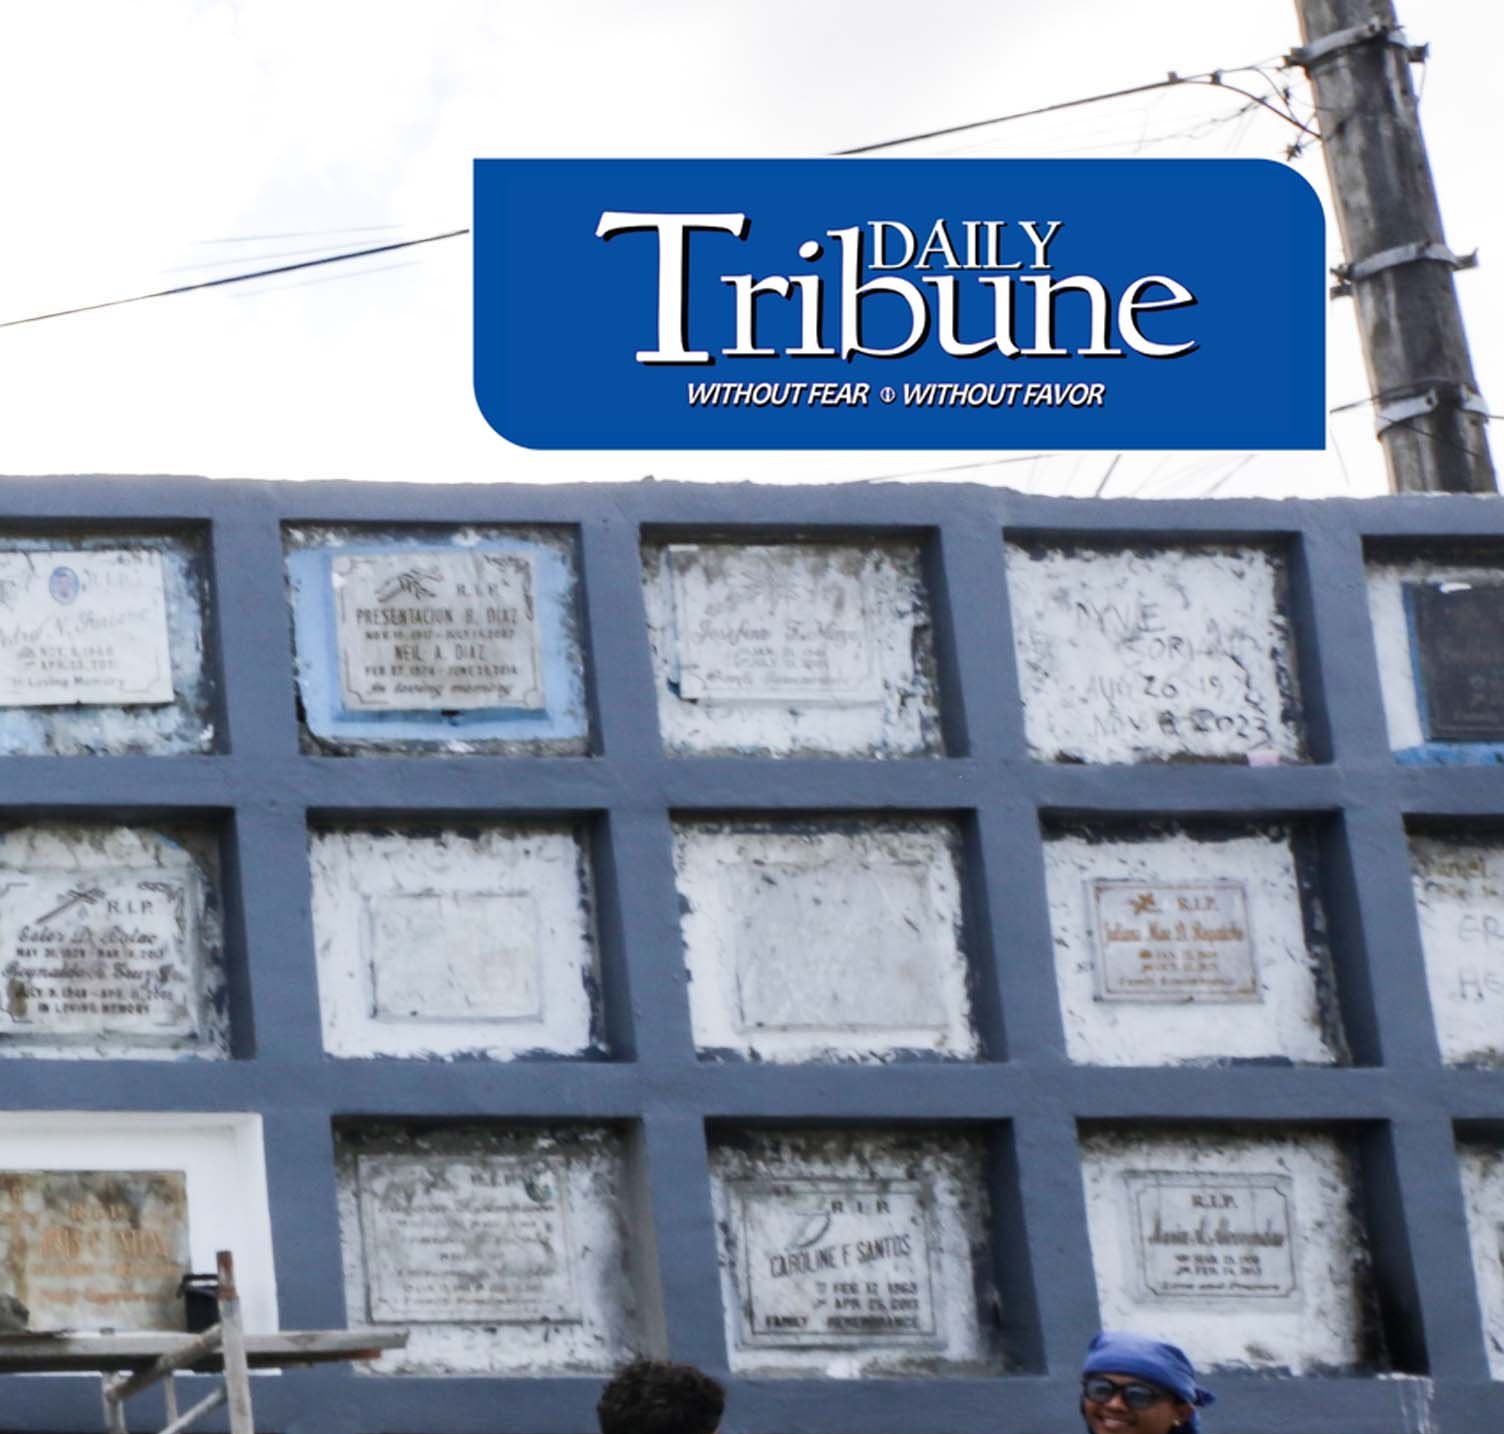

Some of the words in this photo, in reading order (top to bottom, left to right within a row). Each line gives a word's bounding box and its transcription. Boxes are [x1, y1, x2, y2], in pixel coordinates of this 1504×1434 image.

[770, 1245, 836, 1279] CAROLINE
[857, 1233, 912, 1264] SANTOS
[765, 1316, 809, 1328] FAMILY
[827, 1316, 918, 1329] REMEMBRANCE
